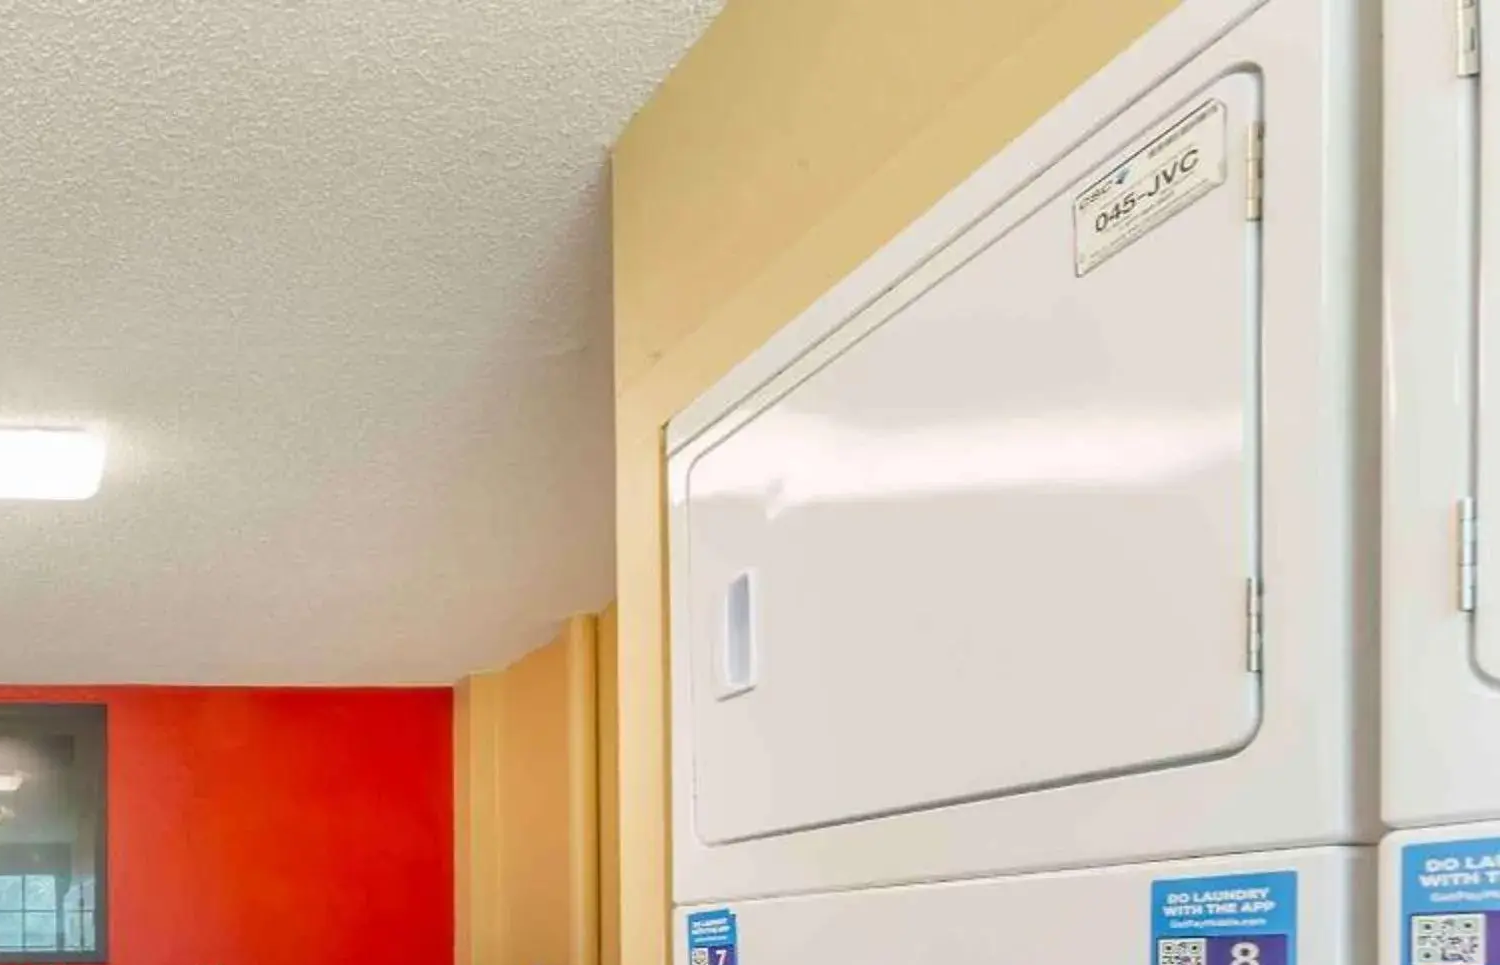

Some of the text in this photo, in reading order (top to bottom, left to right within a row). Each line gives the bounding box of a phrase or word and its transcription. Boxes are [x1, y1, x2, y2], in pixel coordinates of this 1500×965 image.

[1095, 149, 1199, 232] 045-JVC
[1425, 858, 1459, 872] DO
[1418, 873, 1480, 887] WITH
[1166, 887, 1270, 904] DO LAUNDRY
[1162, 900, 1277, 917] WITH THE APP
